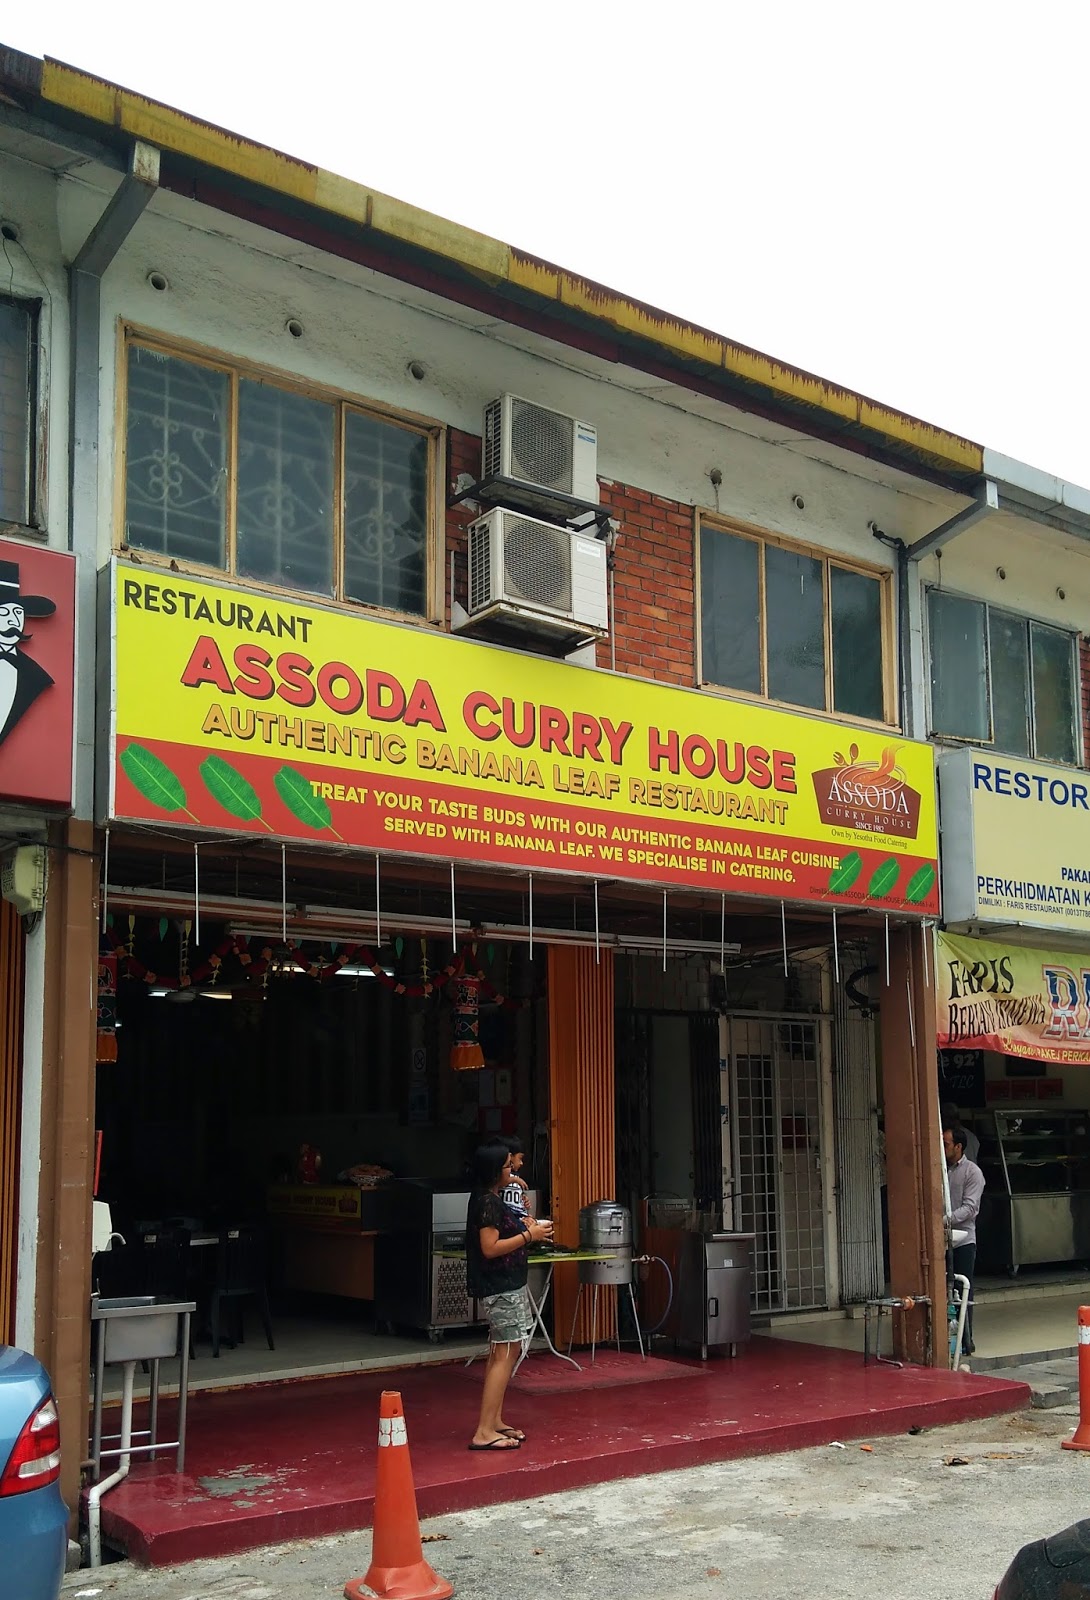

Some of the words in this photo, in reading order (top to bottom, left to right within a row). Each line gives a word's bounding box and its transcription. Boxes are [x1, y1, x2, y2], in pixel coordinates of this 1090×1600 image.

[124, 579, 313, 643] RESTAURANT
[180, 635, 447, 732] ASSODA
[462, 690, 634, 765] CURRY
[648, 726, 798, 794] HOUSE
[201, 704, 407, 764] AUTHENTIC
[416, 738, 545, 788] BANANA
[553, 764, 620, 800] LEAF
[629, 776, 789, 825] RESTAURANT
[827, 775, 909, 815] ASSODA
[973, 763, 1090, 810] RESTOR
[310, 781, 368, 804] TREAT
[373, 790, 423, 812] YOUR
[428, 798, 478, 821] TASTE
[483, 806, 526, 827] BUDS
[530, 813, 570, 834] WITH
[574, 821, 607, 840] OUR
[611, 825, 692, 850] AUTHENTIC
[695, 837, 752, 858] BANANA
[756, 846, 788, 863] LEAF
[791, 850, 843, 871] CUISINE.
[827, 807, 866, 821] CURRY
[874, 815, 912, 830] HOUSE
[855, 821, 872, 832] SINCE
[873, 823, 885, 834] 1982
[384, 816, 447, 838] SERVED
[451, 826, 490, 844] WITH
[495, 832, 556, 855] BANANA
[559, 840, 596, 858] LEAF.
[598, 844, 623, 862] WE
[627, 849, 707, 872] SPECIALISE
[712, 859, 726, 874] IN
[729, 861, 796, 883] CATERING.
[831, 829, 845, 838] Own
[845, 830, 852, 841] by
[853, 831, 873, 843] Yesotha
[874, 835, 887, 845] Food
[887, 837, 908, 850] Catering
[977, 875, 1080, 906] PERKHIDMATAN
[1061, 867, 1090, 883] PAKA
[844, 890, 865, 900] ASSODA
[866, 892, 882, 901] CURRY
[883, 895, 901, 904] HOUSE
[1006, 901, 1024, 910] FARIS
[1025, 902, 1064, 915] RESTAURANT
[947, 956, 1014, 1000] FARIS
[1062, 1050, 1090, 1062] PERKA
